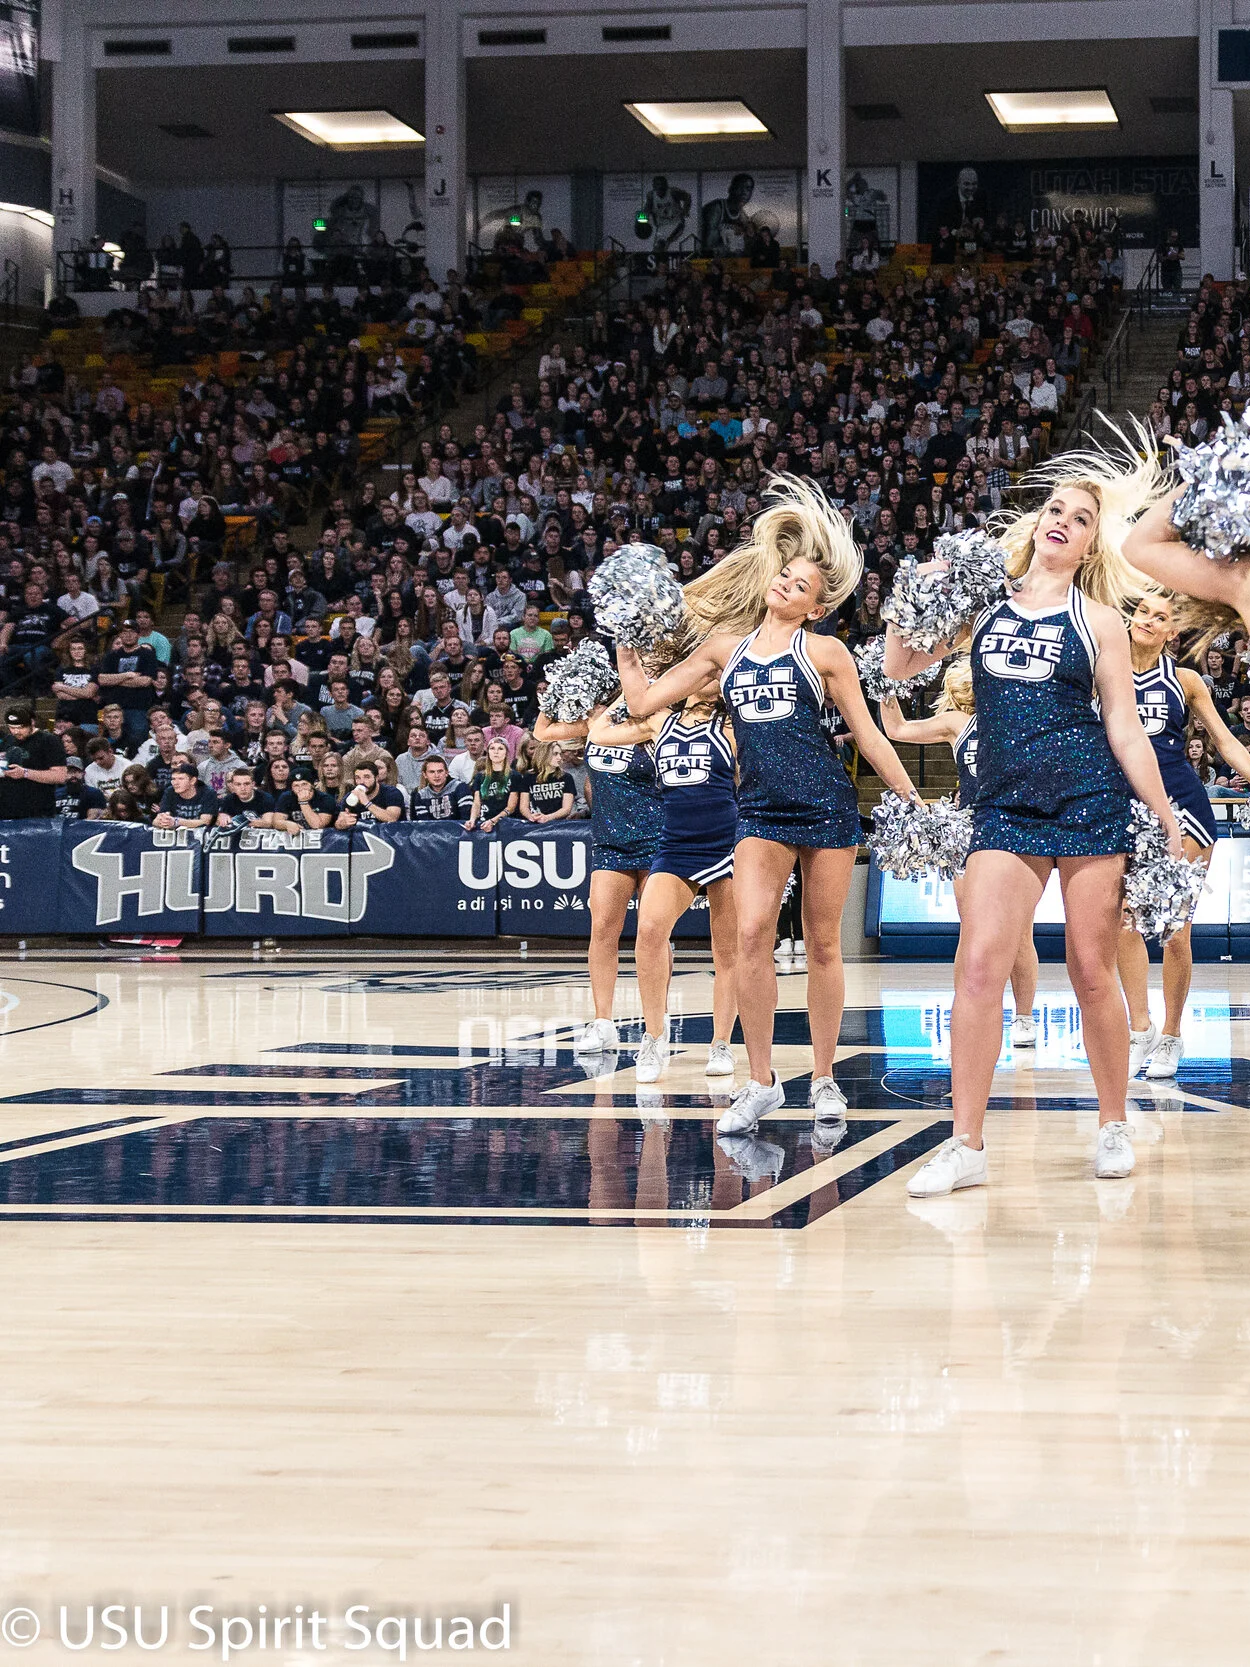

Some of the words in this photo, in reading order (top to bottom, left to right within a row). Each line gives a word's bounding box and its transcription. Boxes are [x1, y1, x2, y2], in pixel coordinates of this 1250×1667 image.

[817, 169, 832, 187] K
[1211, 161, 1223, 178] L
[434, 179, 446, 196] J
[1030, 167, 1120, 198] UTAH
[1131, 166, 1200, 196] STA
[59, 188, 73, 205] H
[979, 633, 1064, 664] STATE
[729, 683, 798, 707] STATE
[1136, 703, 1169, 720] ATE
[586, 744, 635, 763] STATE
[657, 755, 712, 775] STATE
[239, 828, 323, 850] STATE
[457, 840, 587, 890] USU
[71, 830, 396, 926] HURD
